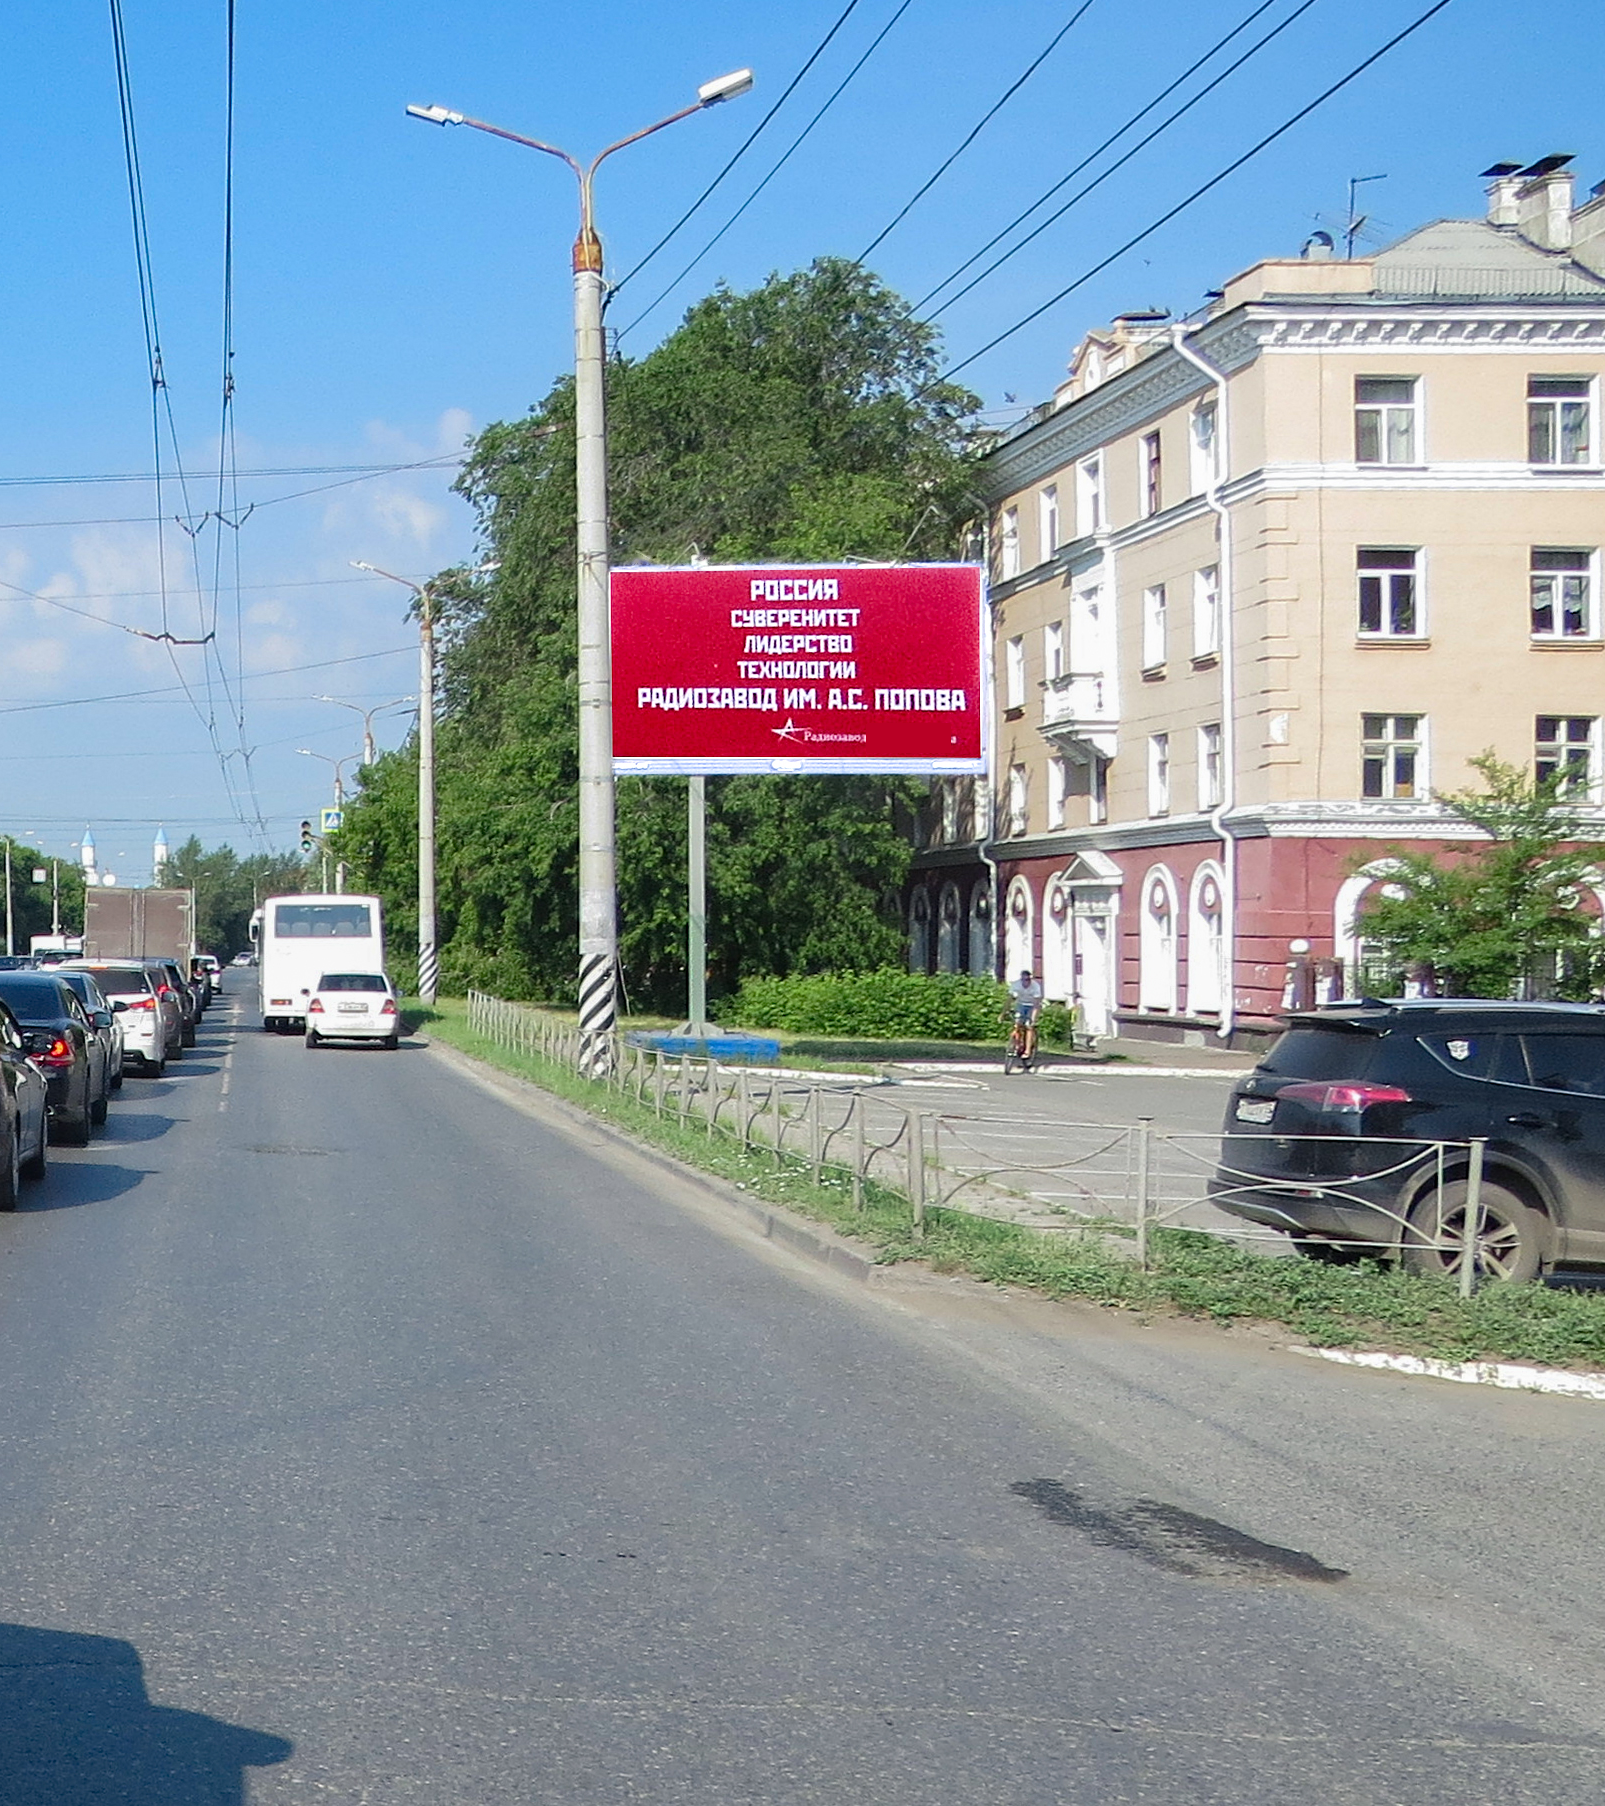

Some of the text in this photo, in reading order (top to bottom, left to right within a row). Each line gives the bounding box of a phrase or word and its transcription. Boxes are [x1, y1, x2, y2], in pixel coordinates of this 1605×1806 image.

[750, 579, 838, 601] РОССИЯ
[730, 609, 861, 628] СУВЕРЕНИТЕТ
[743, 634, 853, 655] ЛИДЕРСТВО
[737, 661, 856, 679] ТЕХНОЛОГИИ
[637, 687, 967, 711] РАДИОЗАВОД ИМ. А.С. ПОПОВА
[804, 731, 867, 743] Радиозавод
